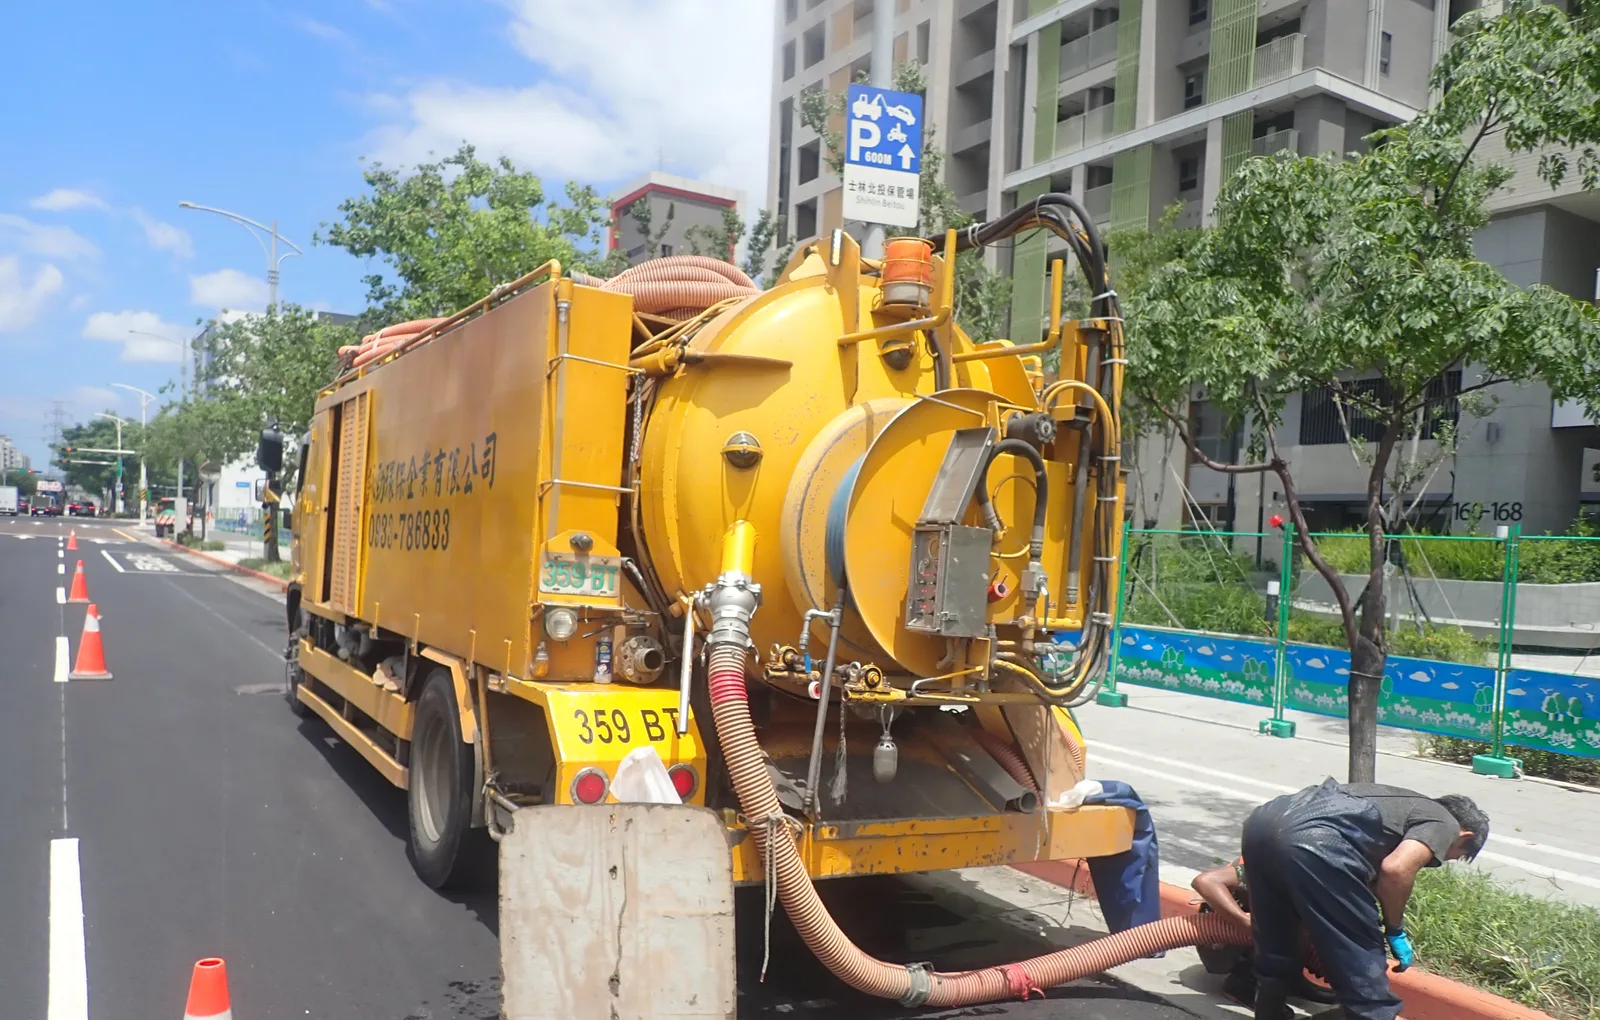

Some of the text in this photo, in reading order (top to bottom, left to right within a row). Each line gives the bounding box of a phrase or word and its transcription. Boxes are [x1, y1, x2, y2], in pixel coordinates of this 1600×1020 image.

[850, 119, 881, 161] P
[865, 151, 892, 165] 600M
[543, 561, 618, 591] 359 BT
[574, 707, 682, 744] 359 BT
